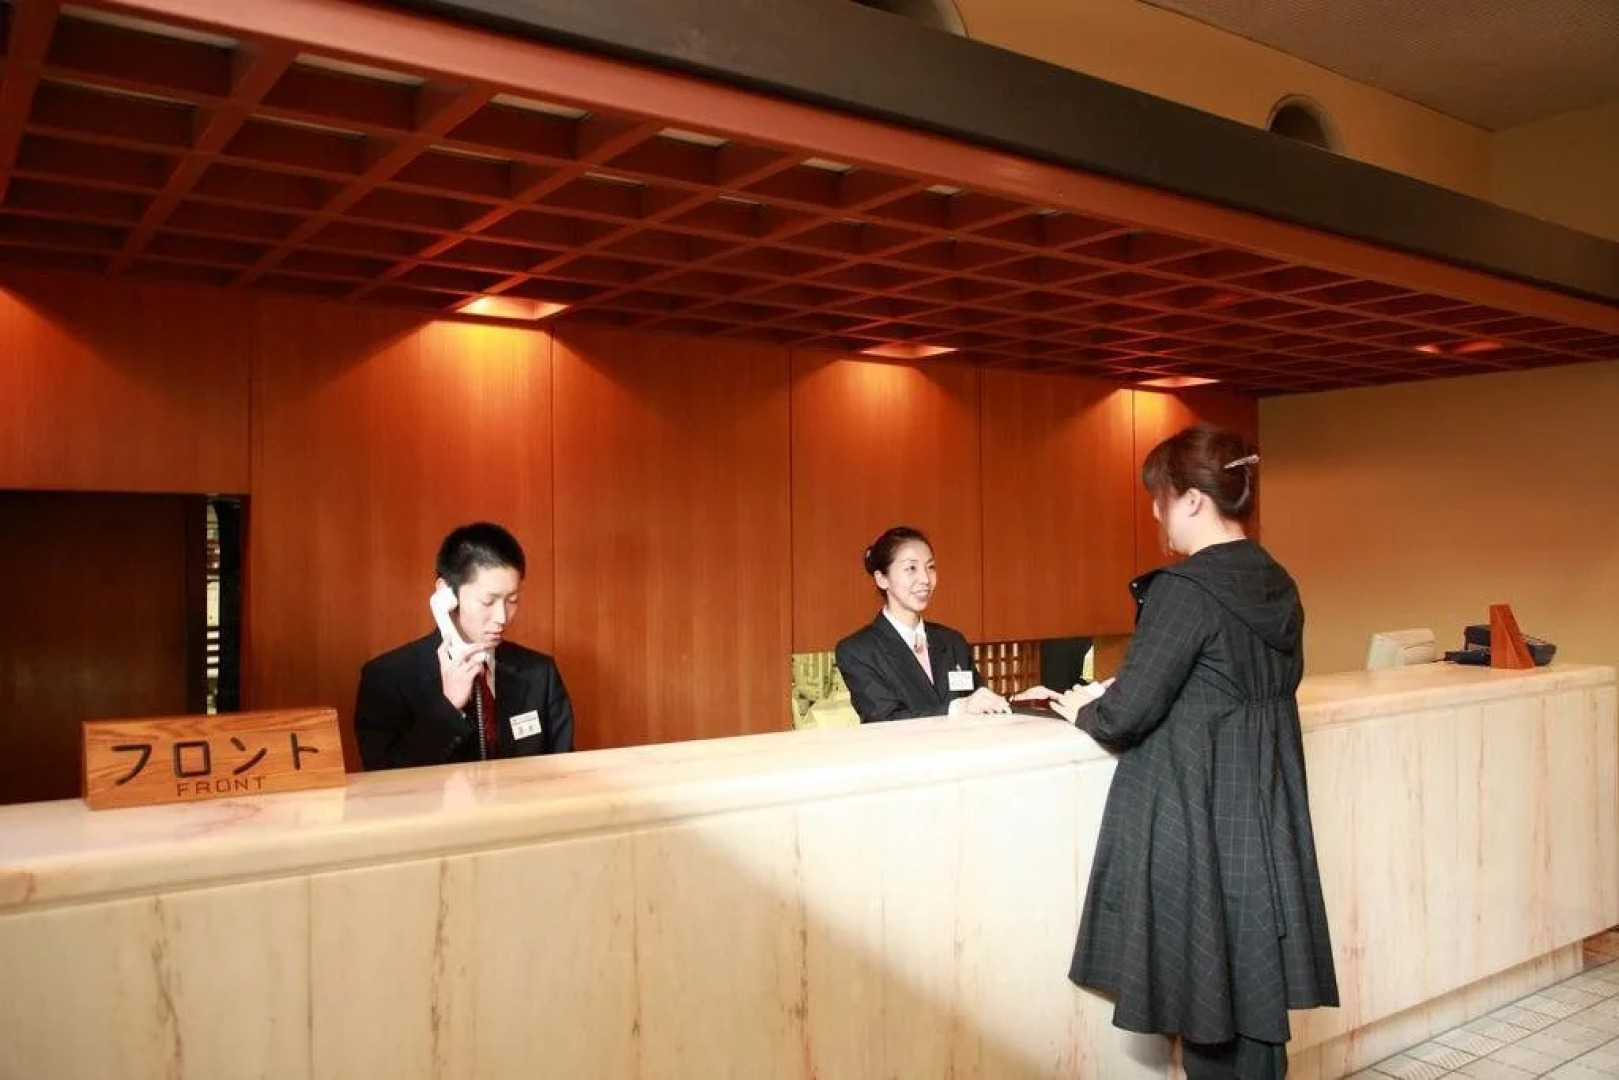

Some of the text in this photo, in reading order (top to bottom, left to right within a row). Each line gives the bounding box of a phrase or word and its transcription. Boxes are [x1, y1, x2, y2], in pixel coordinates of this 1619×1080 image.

[111, 732, 319, 786] フロント
[176, 776, 266, 797] FRONT
